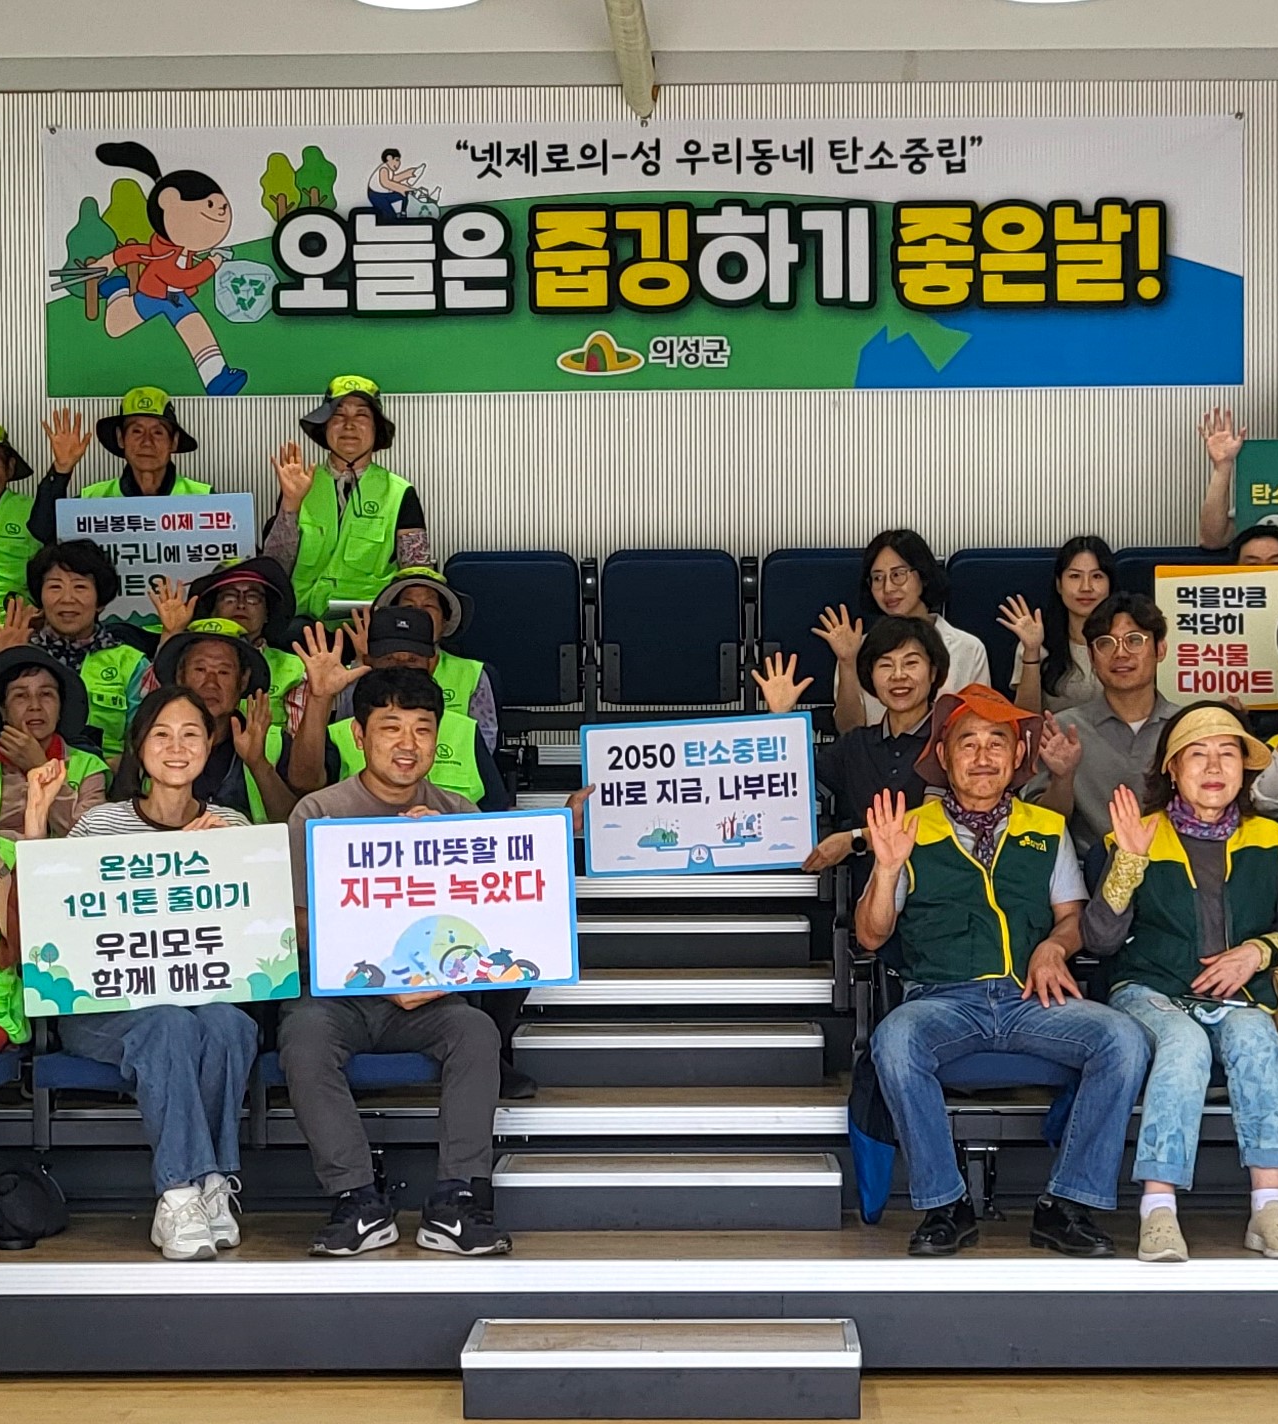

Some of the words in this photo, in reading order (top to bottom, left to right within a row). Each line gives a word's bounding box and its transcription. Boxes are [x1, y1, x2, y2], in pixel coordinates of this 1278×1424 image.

[675, 136, 814, 175] 우리동네
[276, 209, 510, 313] 오늘은
[531, 204, 871, 308] 줍깅하기
[896, 203, 1162, 307] 좋은날!
[648, 336, 730, 367] 의성군
[76, 515, 157, 533] 비닐봉투는
[161, 513, 193, 531] 이제
[198, 511, 237, 531] 그만,
[186, 543, 238, 563] 넣으면
[1176, 586, 1267, 609] 먹을만큼
[1176, 613, 1244, 636] 적당히
[1176, 643, 1249, 667] 음식물
[1177, 670, 1275, 694] 다이어트
[607, 743, 676, 771] 2050
[683, 736, 788, 767] 탄소중립!
[600, 780, 648, 807] 바로
[656, 777, 710, 805] 지금,
[718, 772, 798, 801] 나부터!
[98, 850, 211, 882] 온실가스
[347, 840, 404, 869] 내가
[413, 836, 498, 867] 따뜻할
[507, 834, 534, 862] 때
[63, 891, 107, 918] 1인
[115, 888, 159, 915] 1톤
[167, 881, 251, 913] 줄이기
[339, 875, 436, 909] 지구는
[448, 869, 546, 905] 녹았다
[95, 926, 225, 962] 우리모두
[92, 965, 157, 998] 함께
[168, 961, 233, 993] 해요
